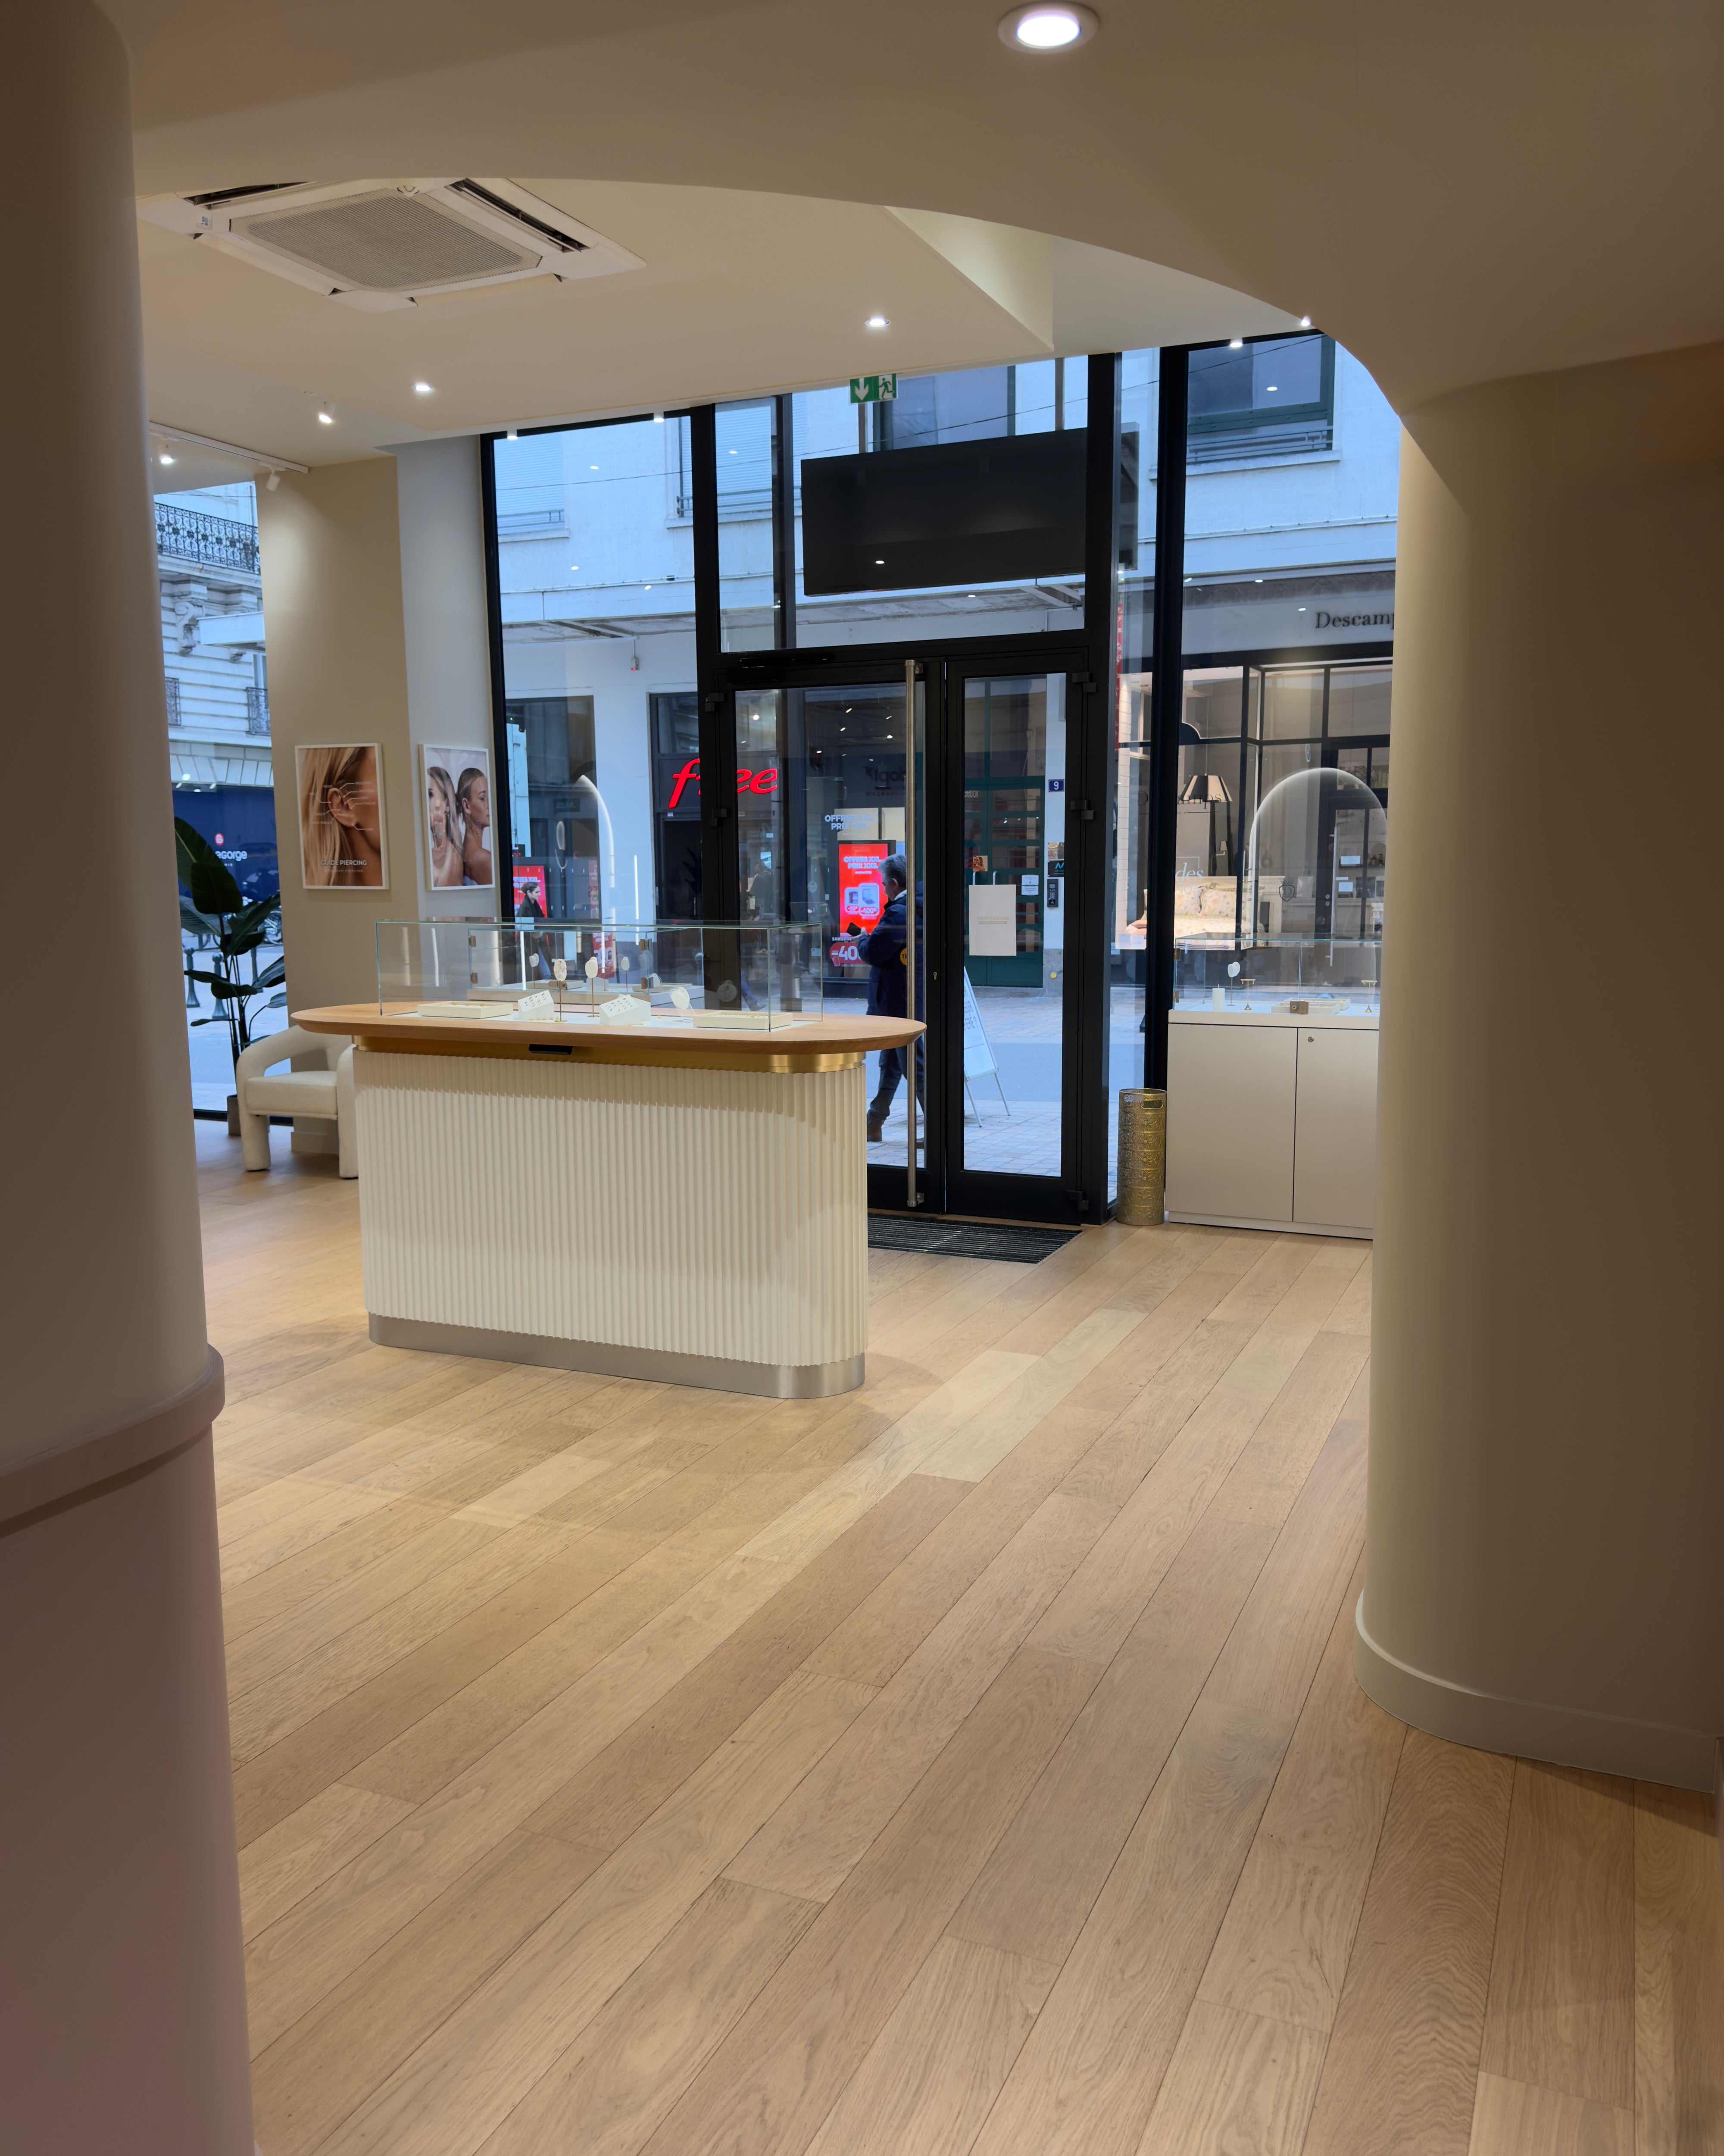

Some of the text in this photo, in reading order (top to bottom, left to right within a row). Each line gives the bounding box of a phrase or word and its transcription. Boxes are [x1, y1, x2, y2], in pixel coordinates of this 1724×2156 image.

[668, 758, 777, 808] fee
[1053, 781, 1059, 790] 9
[831, 945, 862, 961] -40
